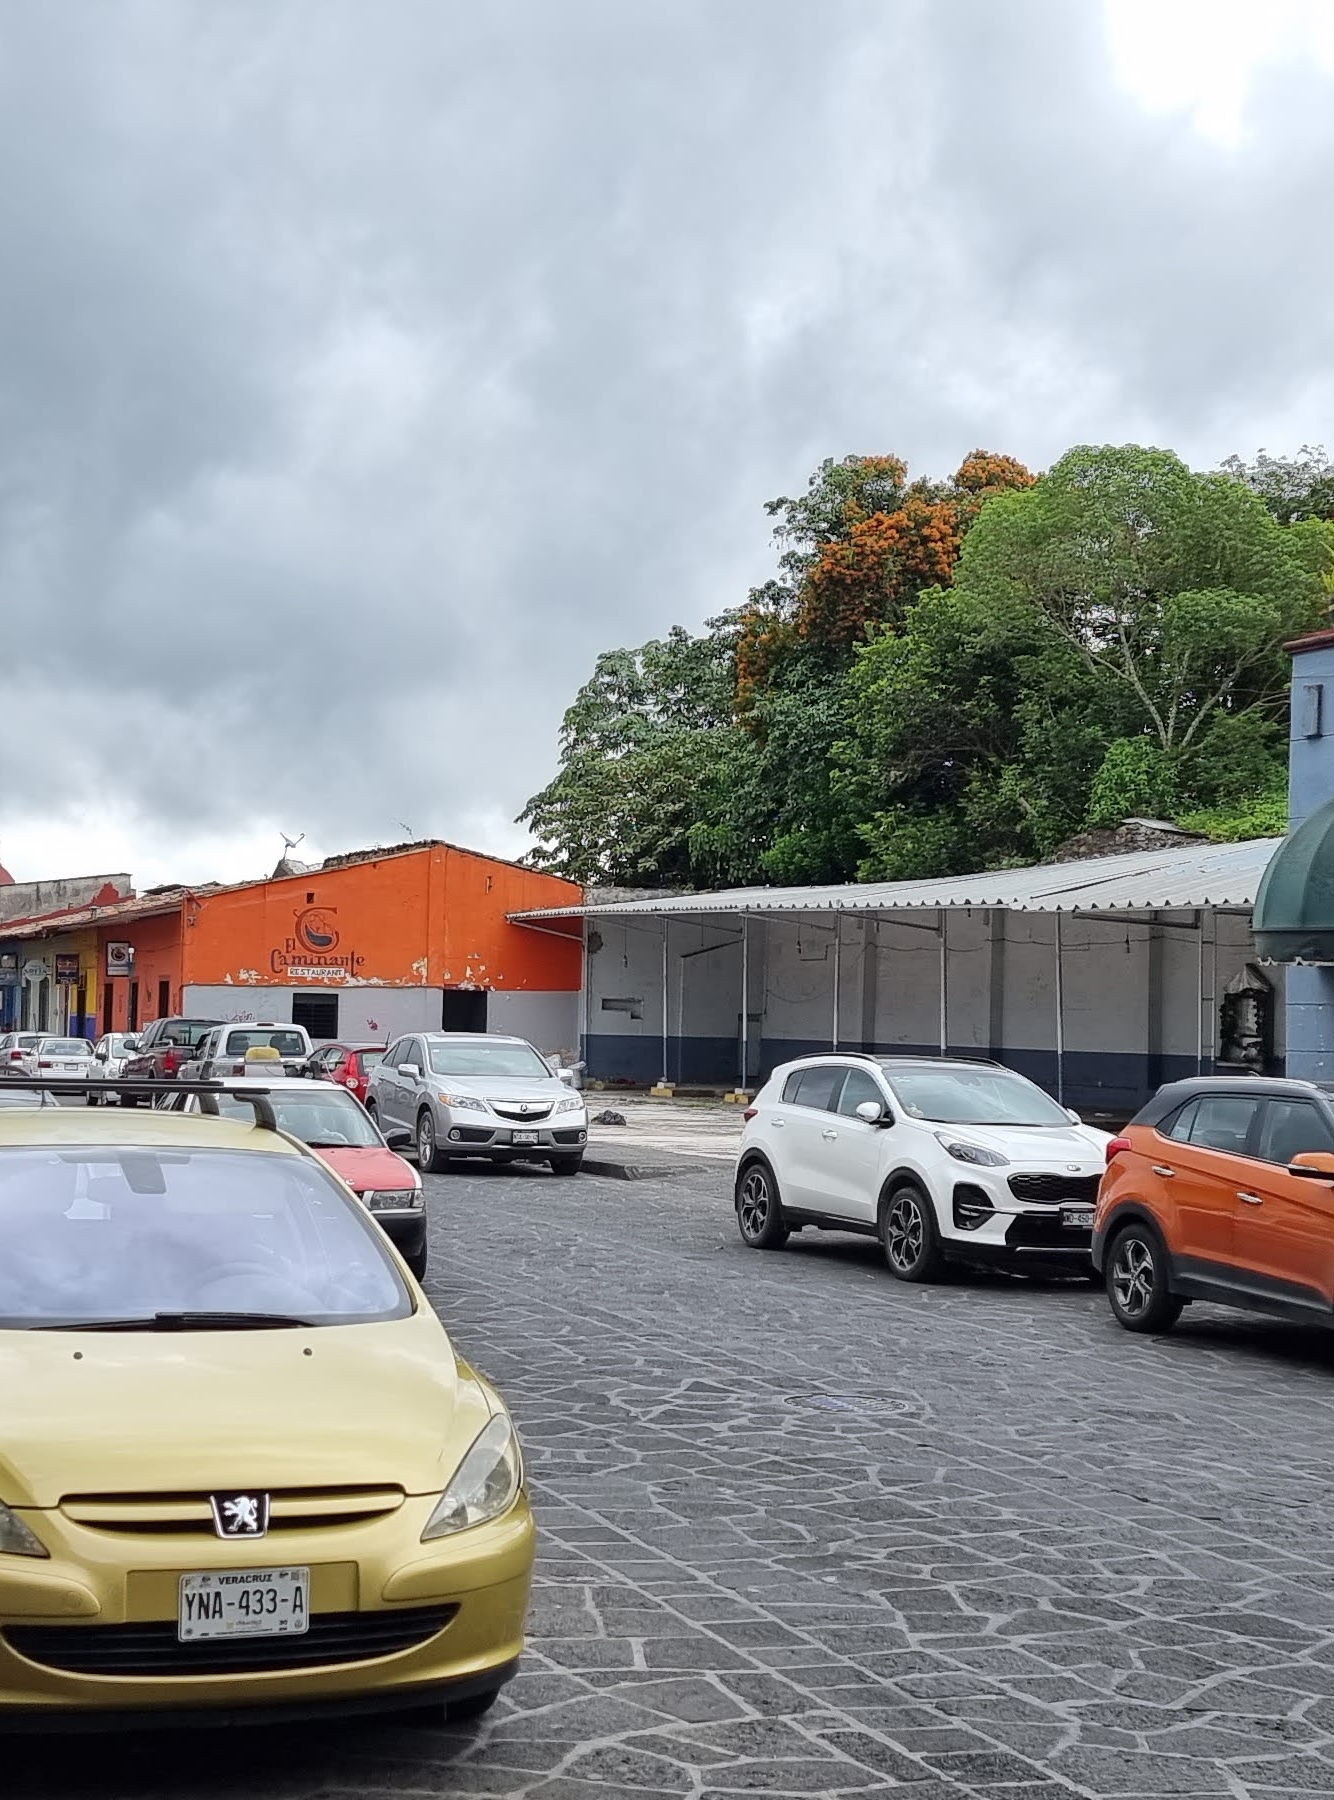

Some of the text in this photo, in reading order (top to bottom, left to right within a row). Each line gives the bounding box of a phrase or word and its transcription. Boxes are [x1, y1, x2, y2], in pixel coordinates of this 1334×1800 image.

[285, 938, 295, 953] El
[271, 949, 365, 977] Caminante
[289, 968, 343, 976] RESTAURANT
[218, 1574, 273, 1586] VERACRUZ
[185, 1586, 303, 1620] YNA-433-A
